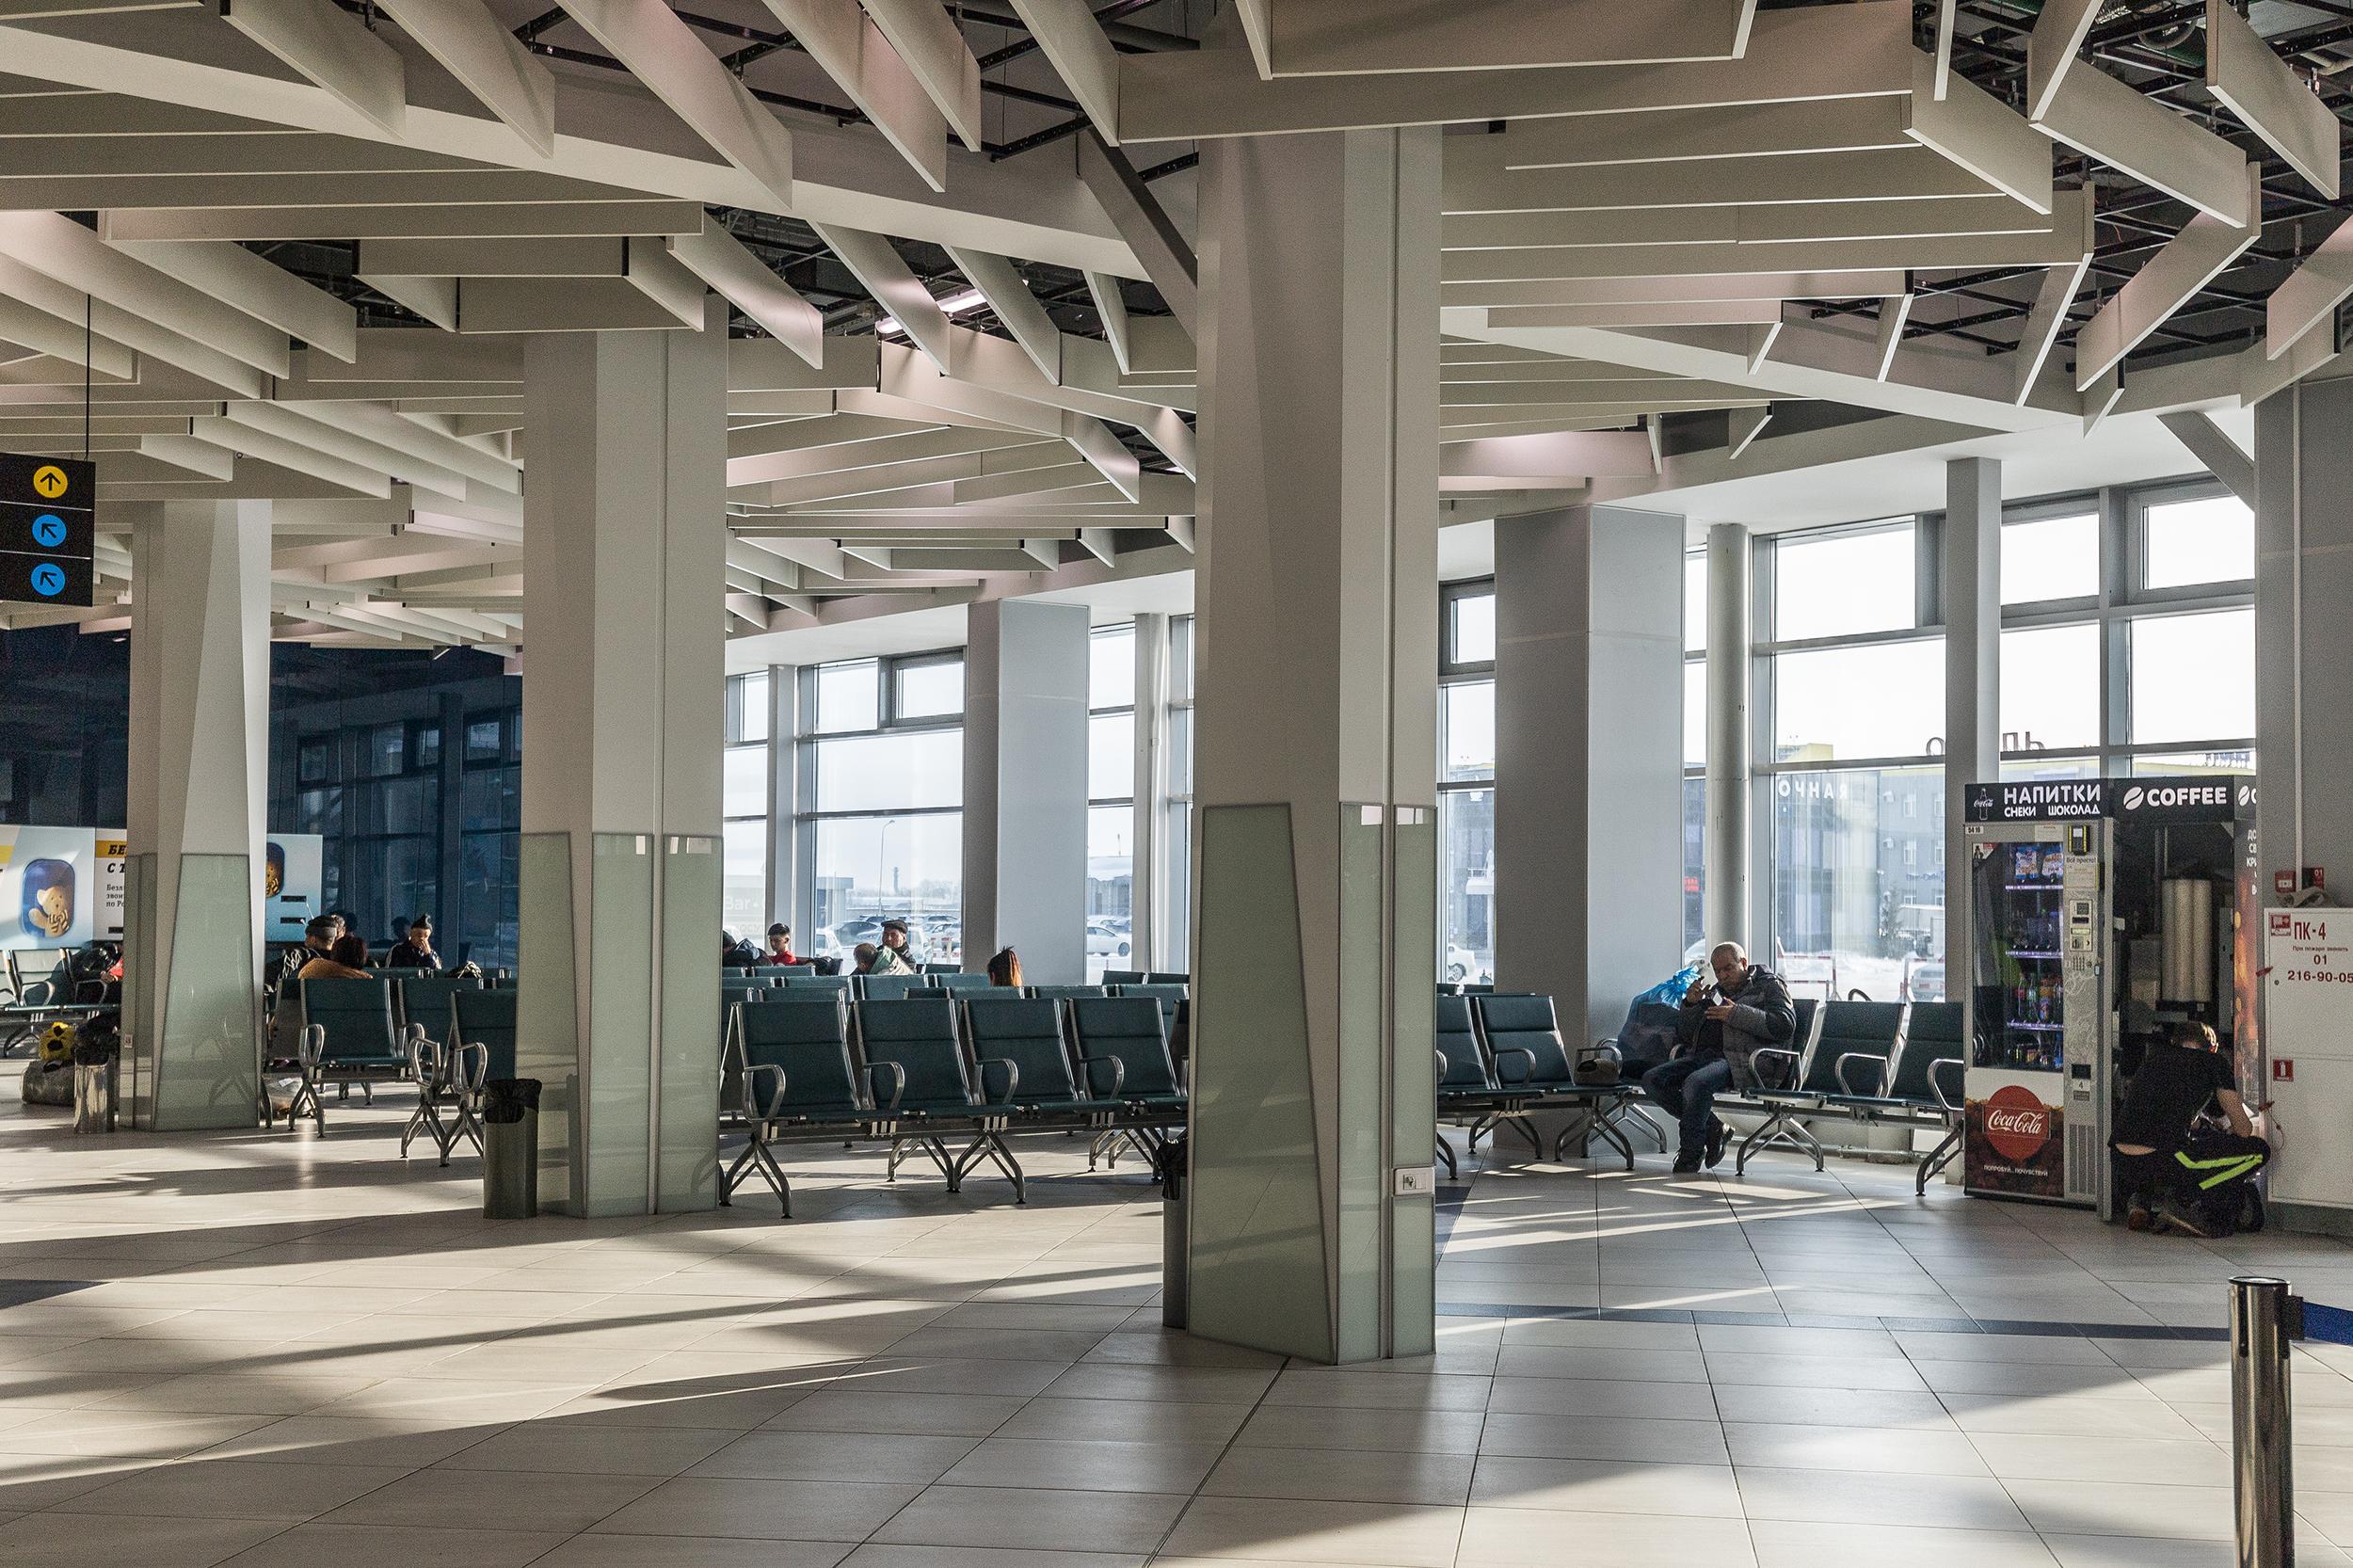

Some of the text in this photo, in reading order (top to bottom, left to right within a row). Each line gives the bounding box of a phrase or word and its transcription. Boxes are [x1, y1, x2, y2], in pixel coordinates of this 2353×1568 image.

[2004, 784, 2101, 805] НАПИТКИ
[2147, 787, 2227, 807] COFFEE
[2004, 804, 2101, 817] СНЕКИ ШОКОЛАД
[2313, 954, 2328, 965] 01
[2287, 970, 2353, 984] 216-90-05
